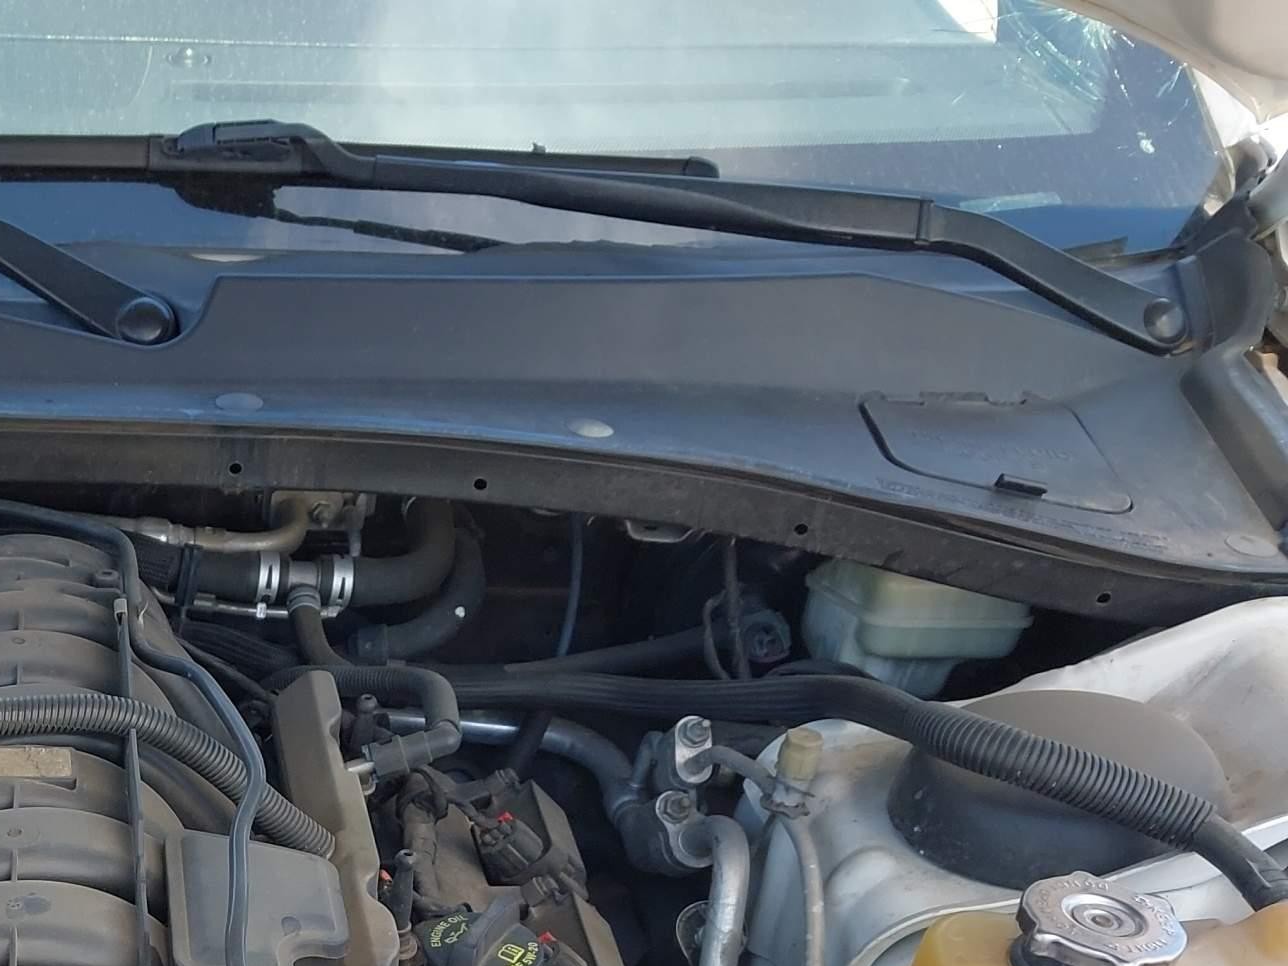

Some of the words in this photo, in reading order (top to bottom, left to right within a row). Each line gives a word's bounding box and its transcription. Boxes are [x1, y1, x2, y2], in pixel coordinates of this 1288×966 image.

[431, 921, 450, 947] ENGINE
[448, 914, 468, 923] OIL
[523, 942, 538, 965] 5W-20
